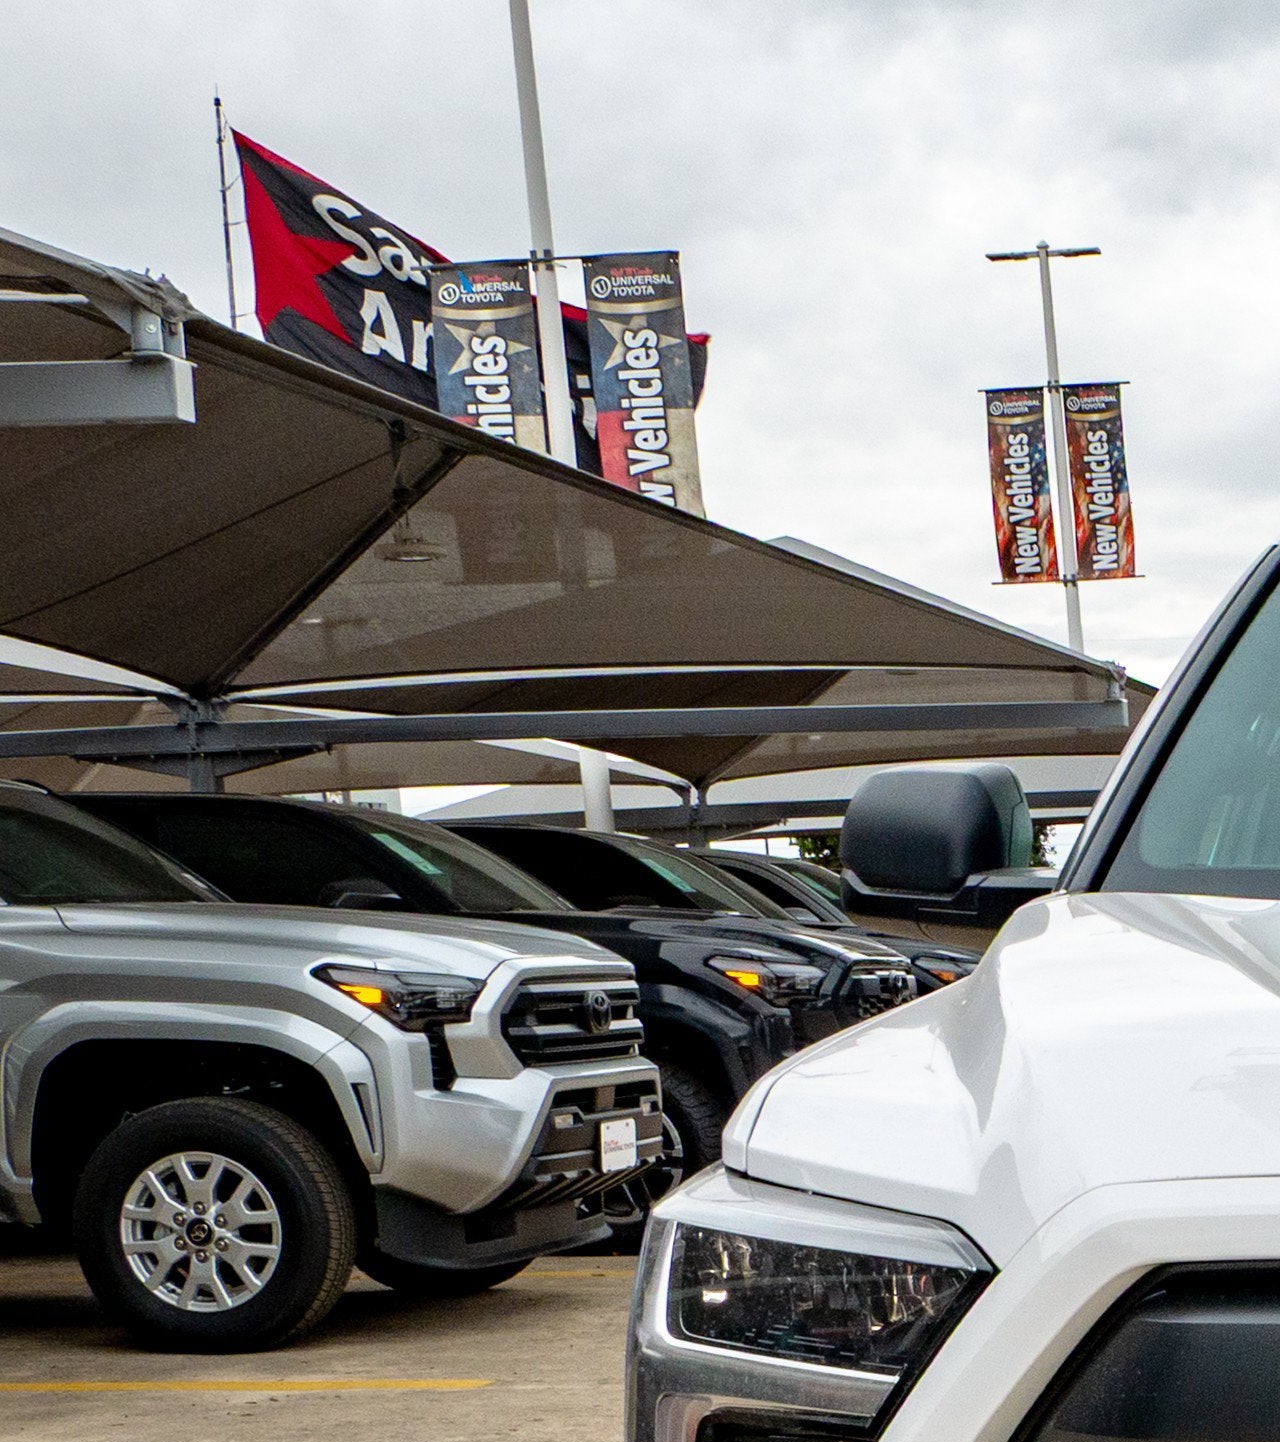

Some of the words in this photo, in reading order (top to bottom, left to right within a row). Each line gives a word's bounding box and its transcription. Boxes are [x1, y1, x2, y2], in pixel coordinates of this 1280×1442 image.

[461, 291, 504, 303] TOYOTA
[612, 273, 674, 286] UNIVERSAL
[612, 285, 655, 297] TOYOTA
[618, 328, 671, 477] Vehicles
[1003, 432, 1035, 523] Vehicles
[1083, 429, 1115, 520] Vehicles
[1013, 525, 1042, 574] New
[1092, 523, 1119, 571] New
